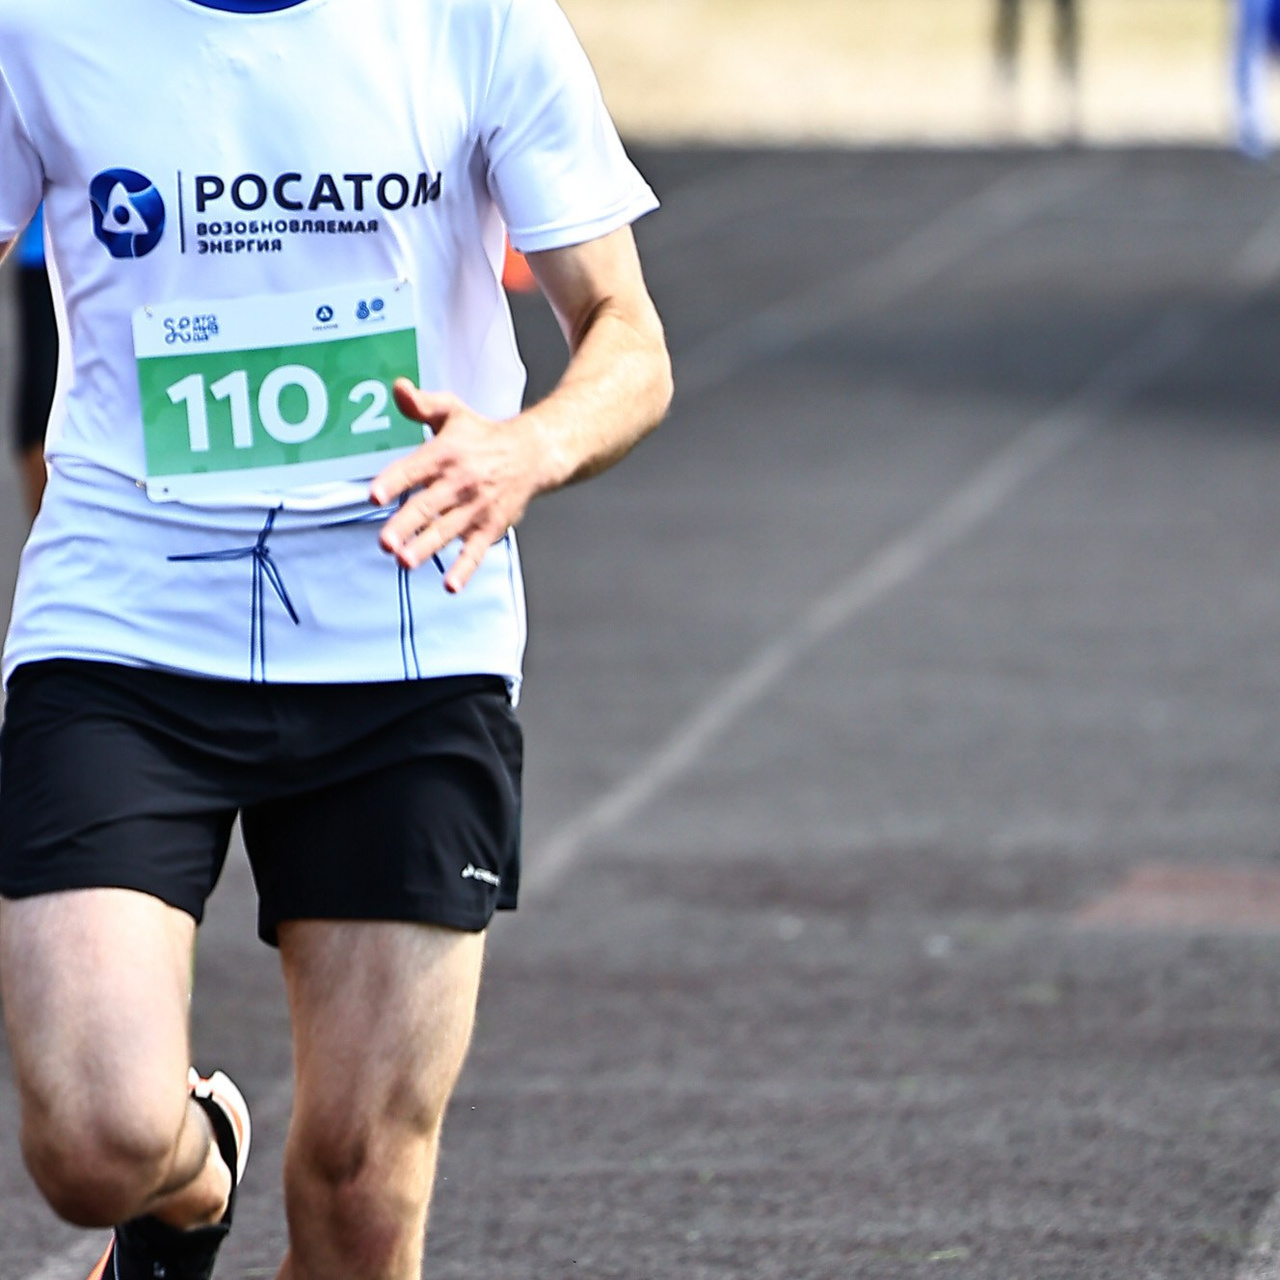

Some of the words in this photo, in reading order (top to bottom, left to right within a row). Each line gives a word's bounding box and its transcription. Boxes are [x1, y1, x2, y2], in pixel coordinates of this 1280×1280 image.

[197, 220, 379, 236] ВОЗОБНОВЛЯЕМАЯ
[198, 238, 282, 254] ЭНЕРГИЯ
[166, 365, 328, 452] 110
[350, 380, 390, 435] 2
